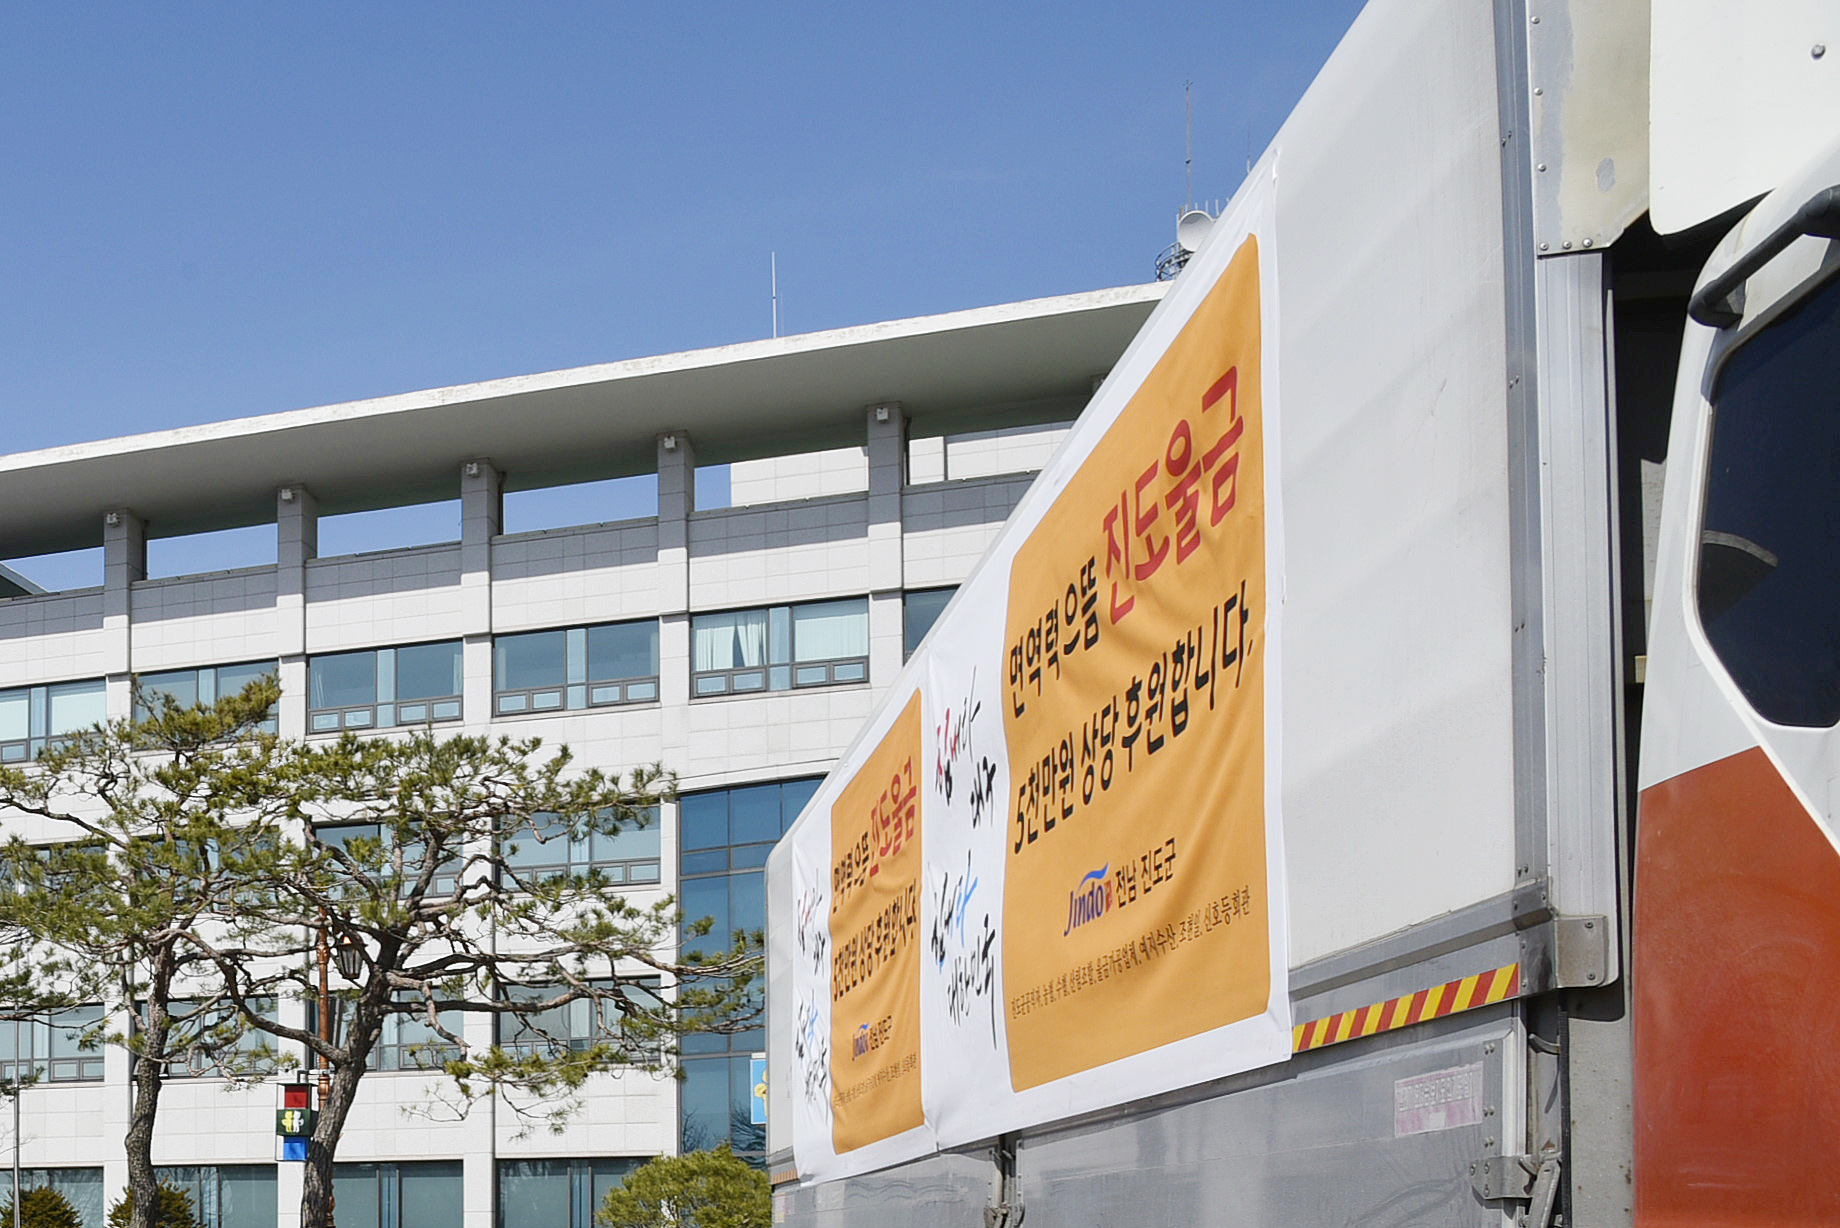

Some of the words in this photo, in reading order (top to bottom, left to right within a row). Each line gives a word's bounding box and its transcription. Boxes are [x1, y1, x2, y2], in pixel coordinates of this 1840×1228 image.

[1010, 555, 1100, 719] 면역력으뜸
[1103, 365, 1245, 625] 진도울금
[870, 755, 918, 878] 진도울금
[1014, 730, 1075, 855] 5천만원
[1063, 880, 1104, 937] Jindo
[1115, 859, 1137, 909] 전남
[1141, 837, 1176, 895] 진도군
